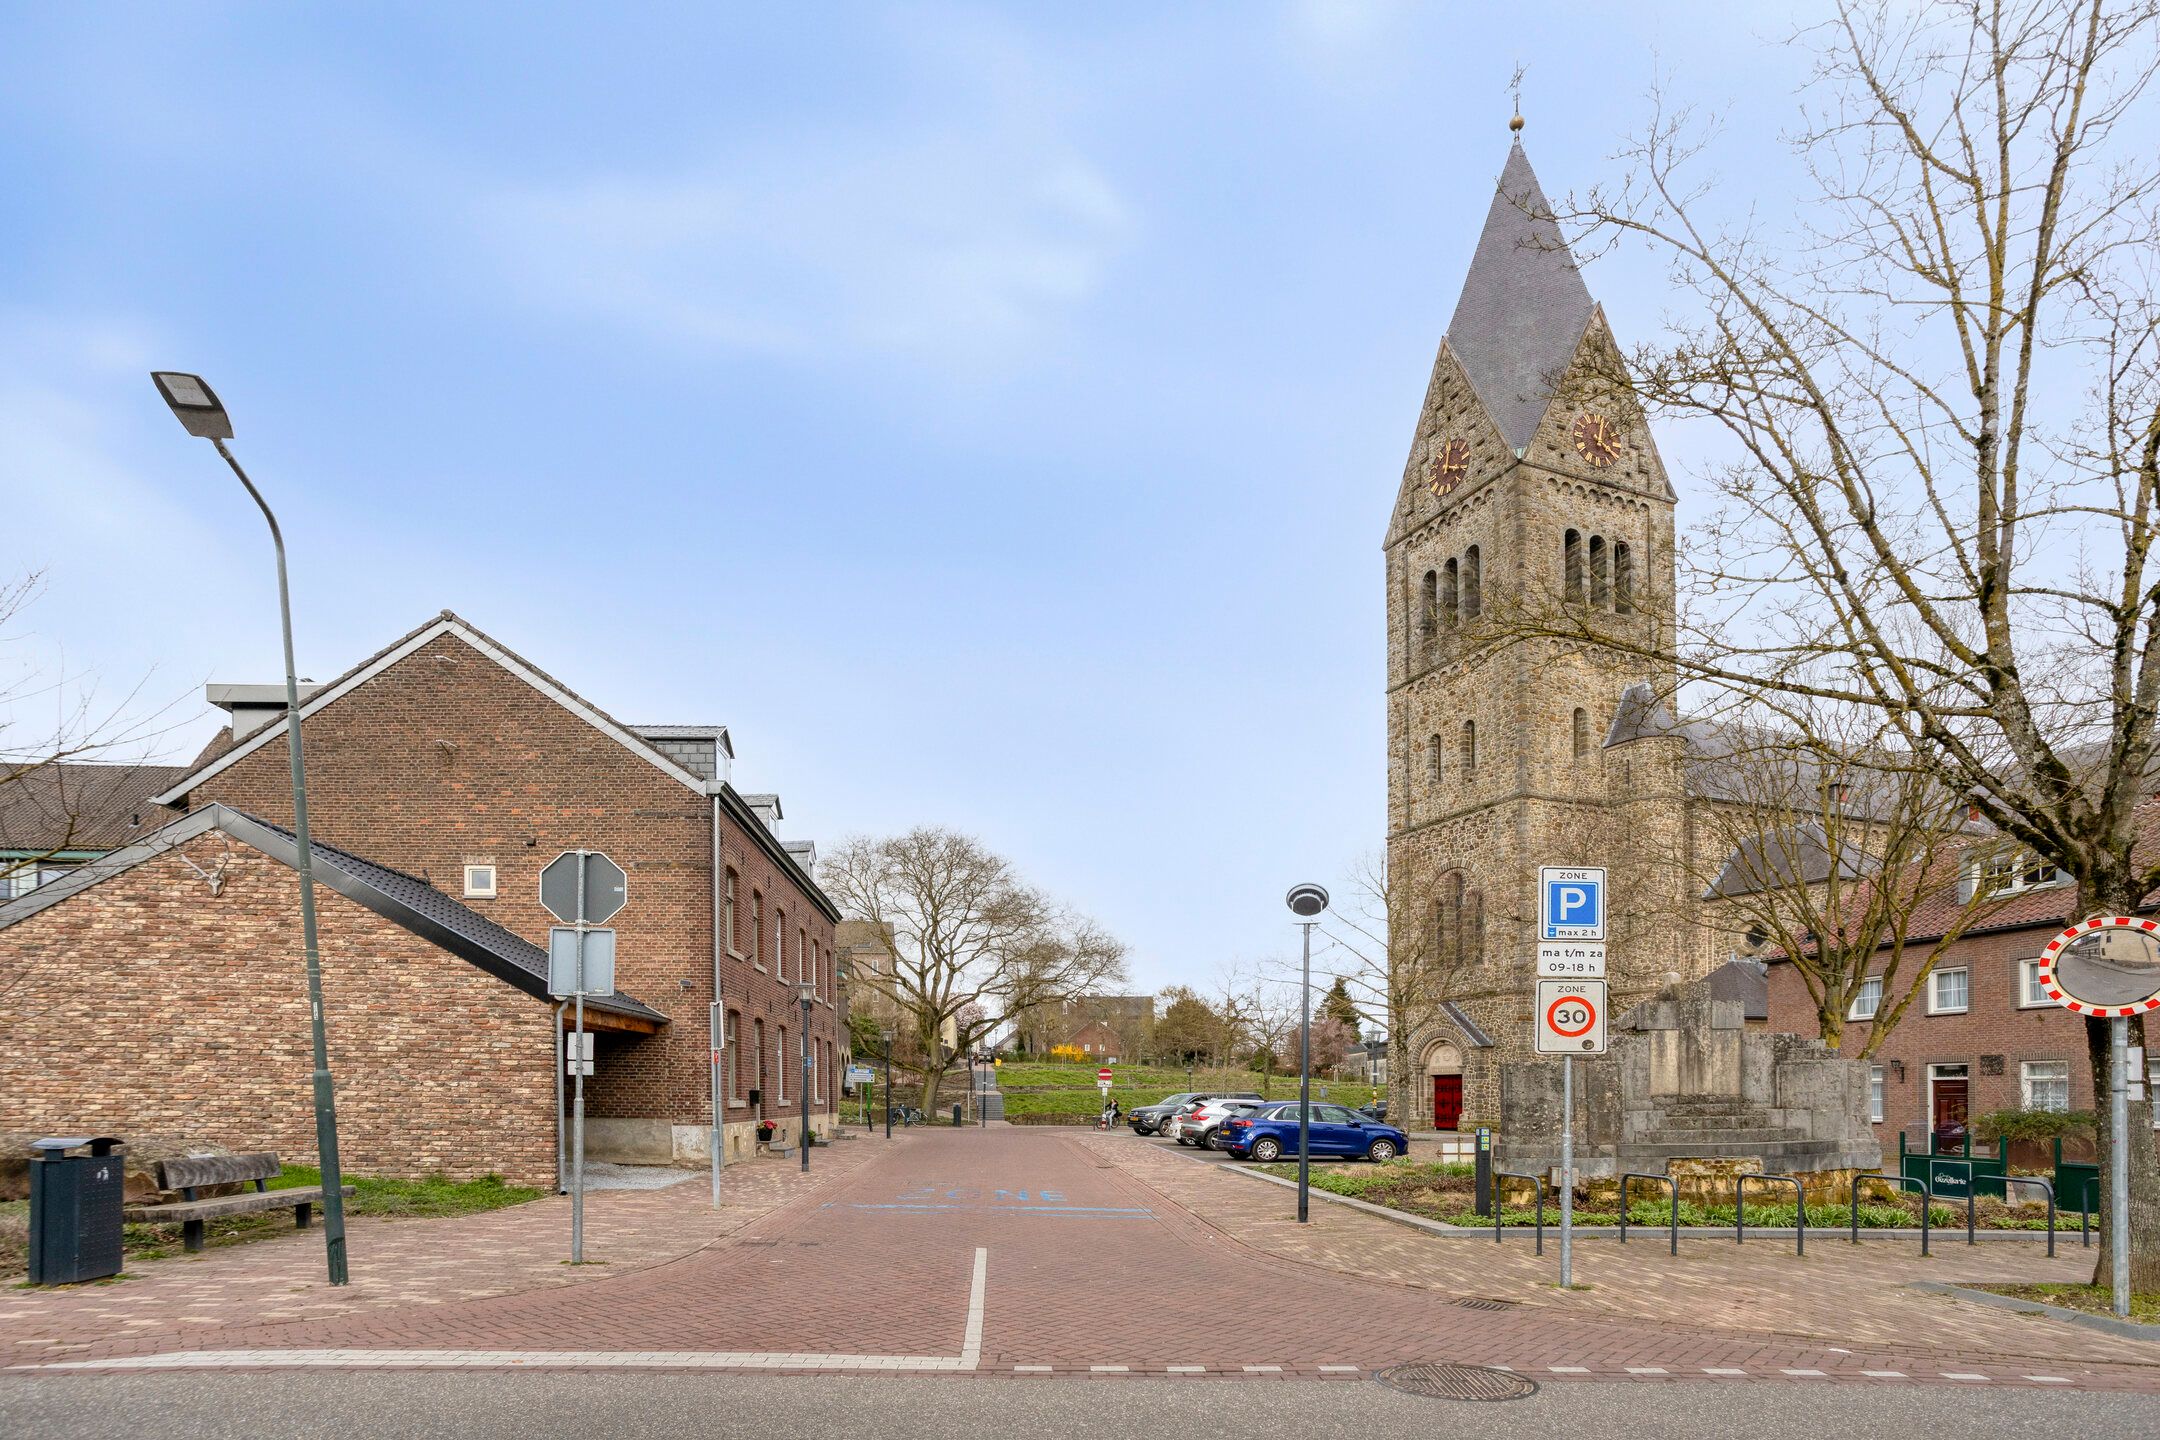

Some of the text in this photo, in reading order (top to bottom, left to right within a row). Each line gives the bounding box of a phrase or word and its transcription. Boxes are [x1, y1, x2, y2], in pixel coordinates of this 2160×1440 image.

[1559, 871, 1588, 880] ZONE
[1560, 887, 1587, 921] P
[1581, 929, 1588, 937] 2
[1591, 929, 1597, 937] h
[1542, 948, 1603, 958] ma t/m za
[1549, 962, 1596, 972] 09-18 h
[1557, 985, 1587, 993] ZONE
[1557, 1009, 1587, 1024] 30
